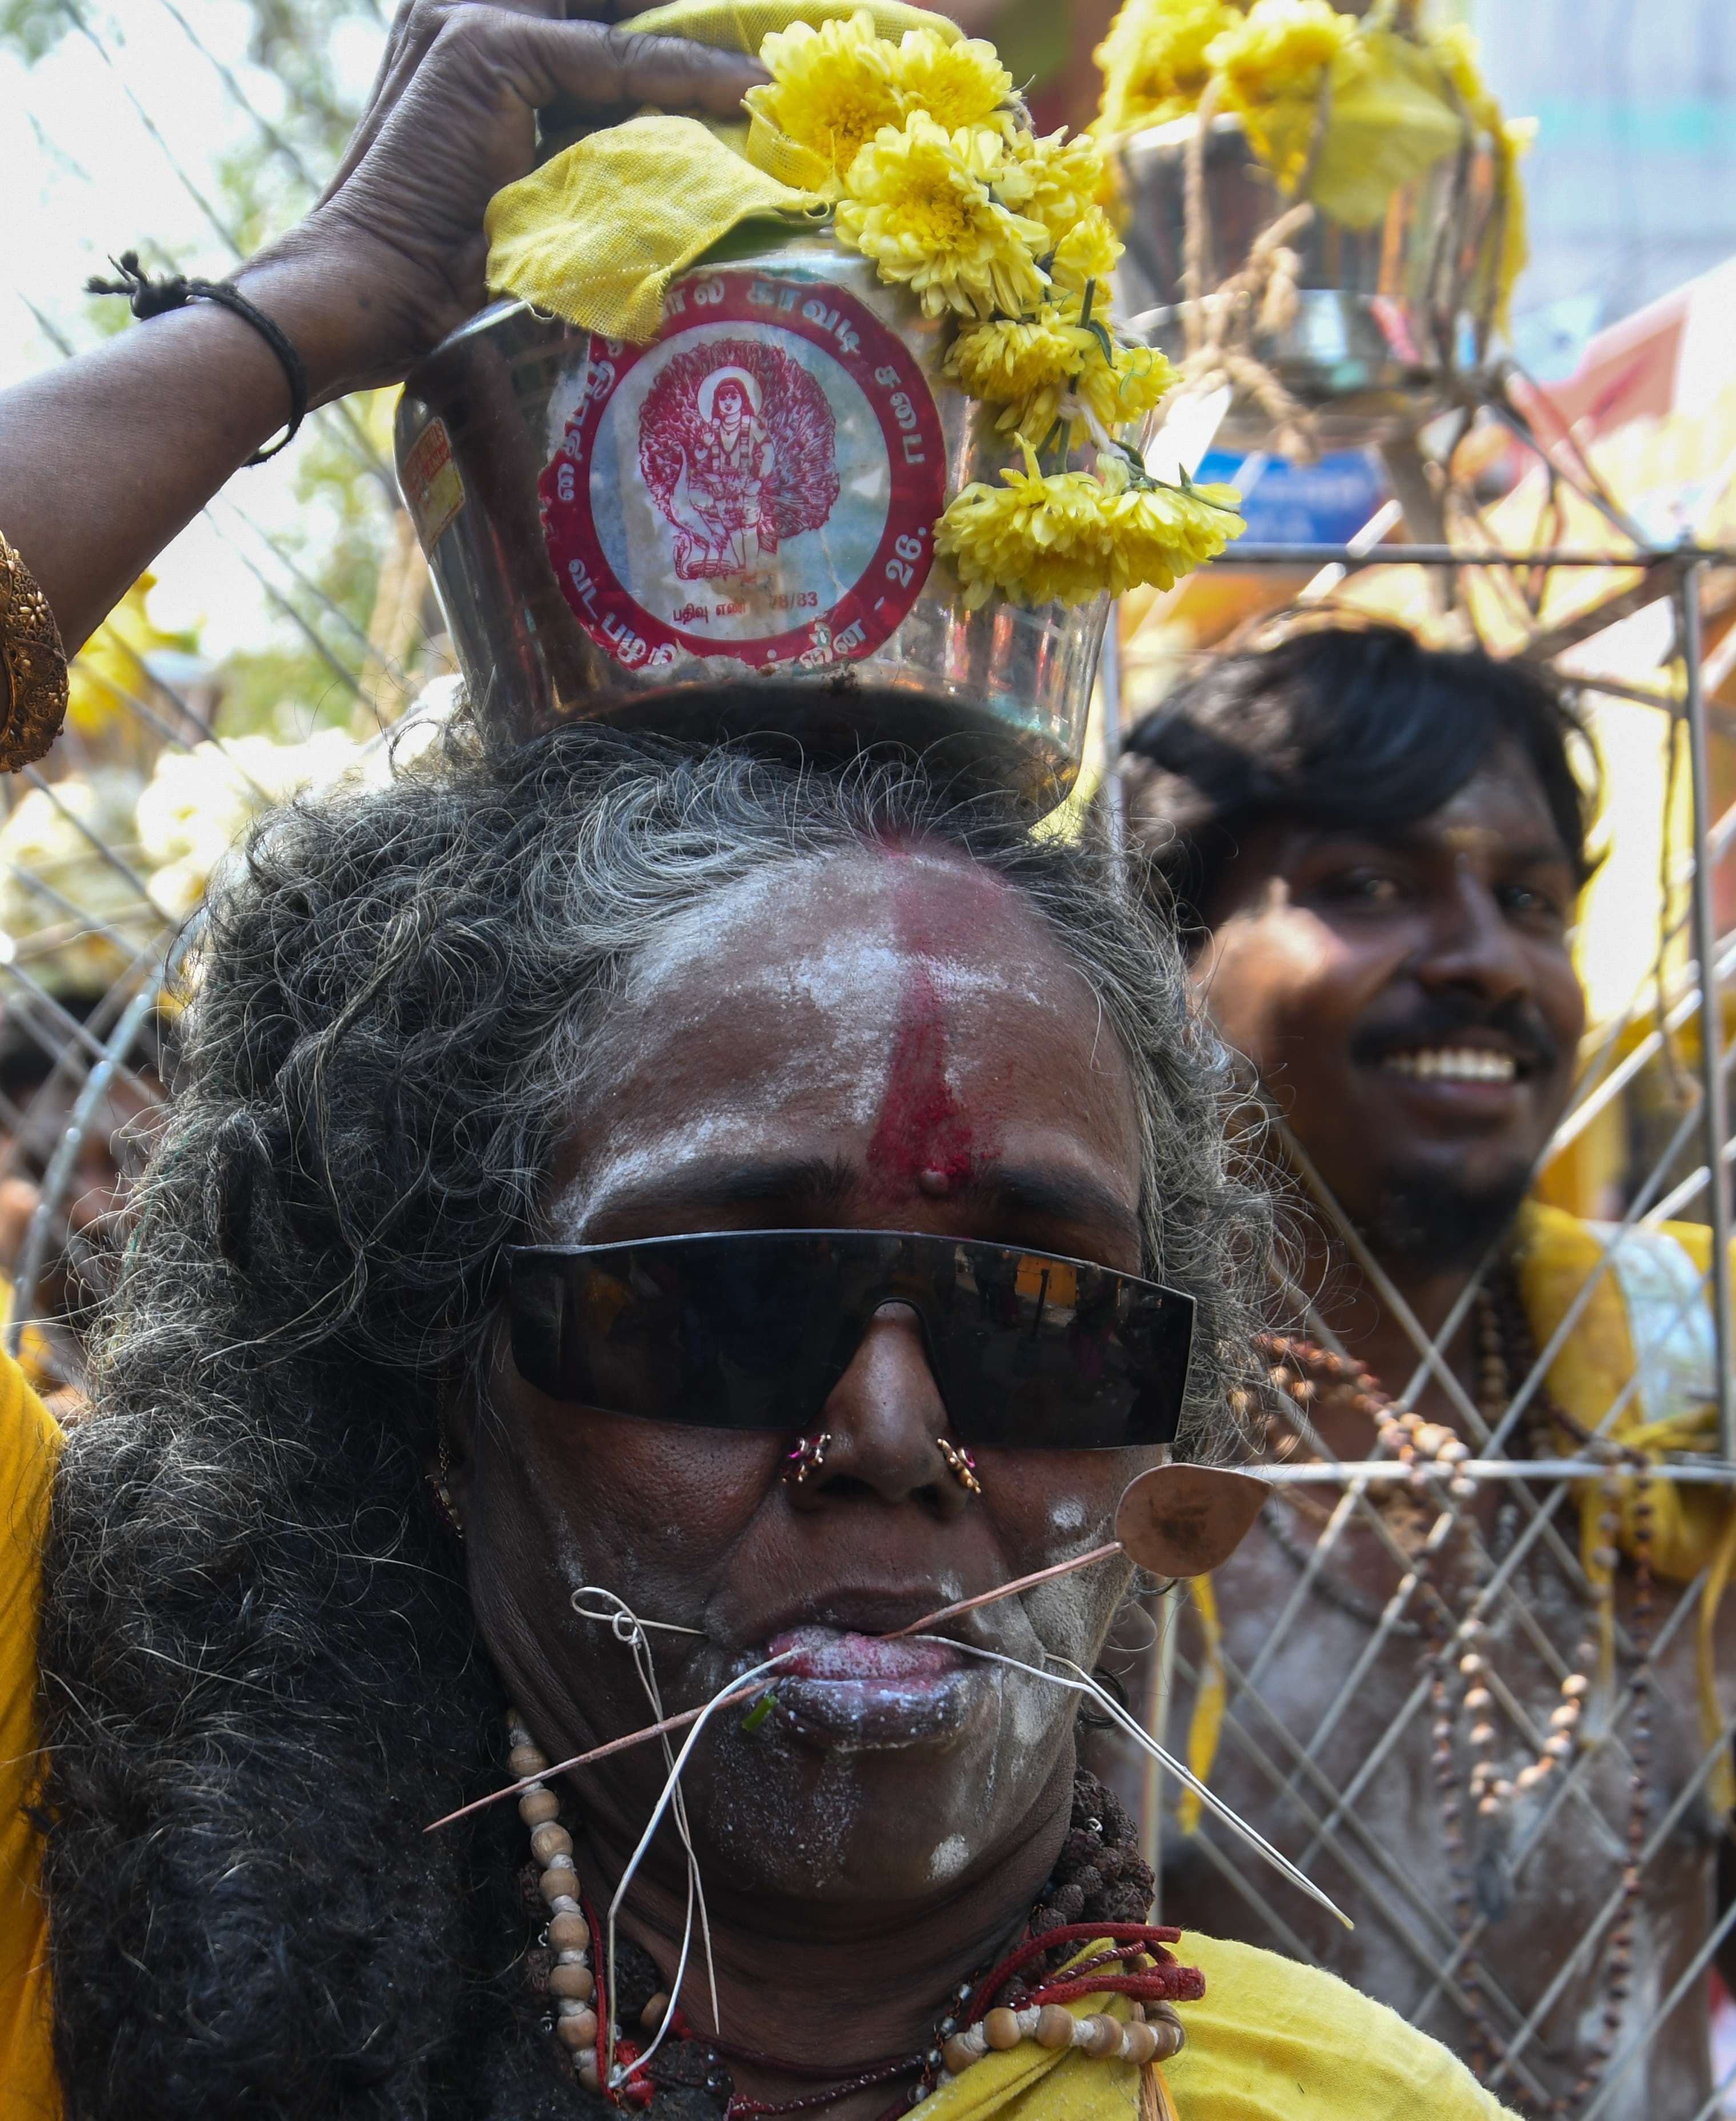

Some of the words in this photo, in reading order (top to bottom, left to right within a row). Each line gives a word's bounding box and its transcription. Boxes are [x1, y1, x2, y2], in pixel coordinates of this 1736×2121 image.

[746, 280, 861, 356] காவடி
[874, 365, 926, 463] சபை
[885, 526, 927, 589] 26.
[673, 602, 709, 625] பதிவு
